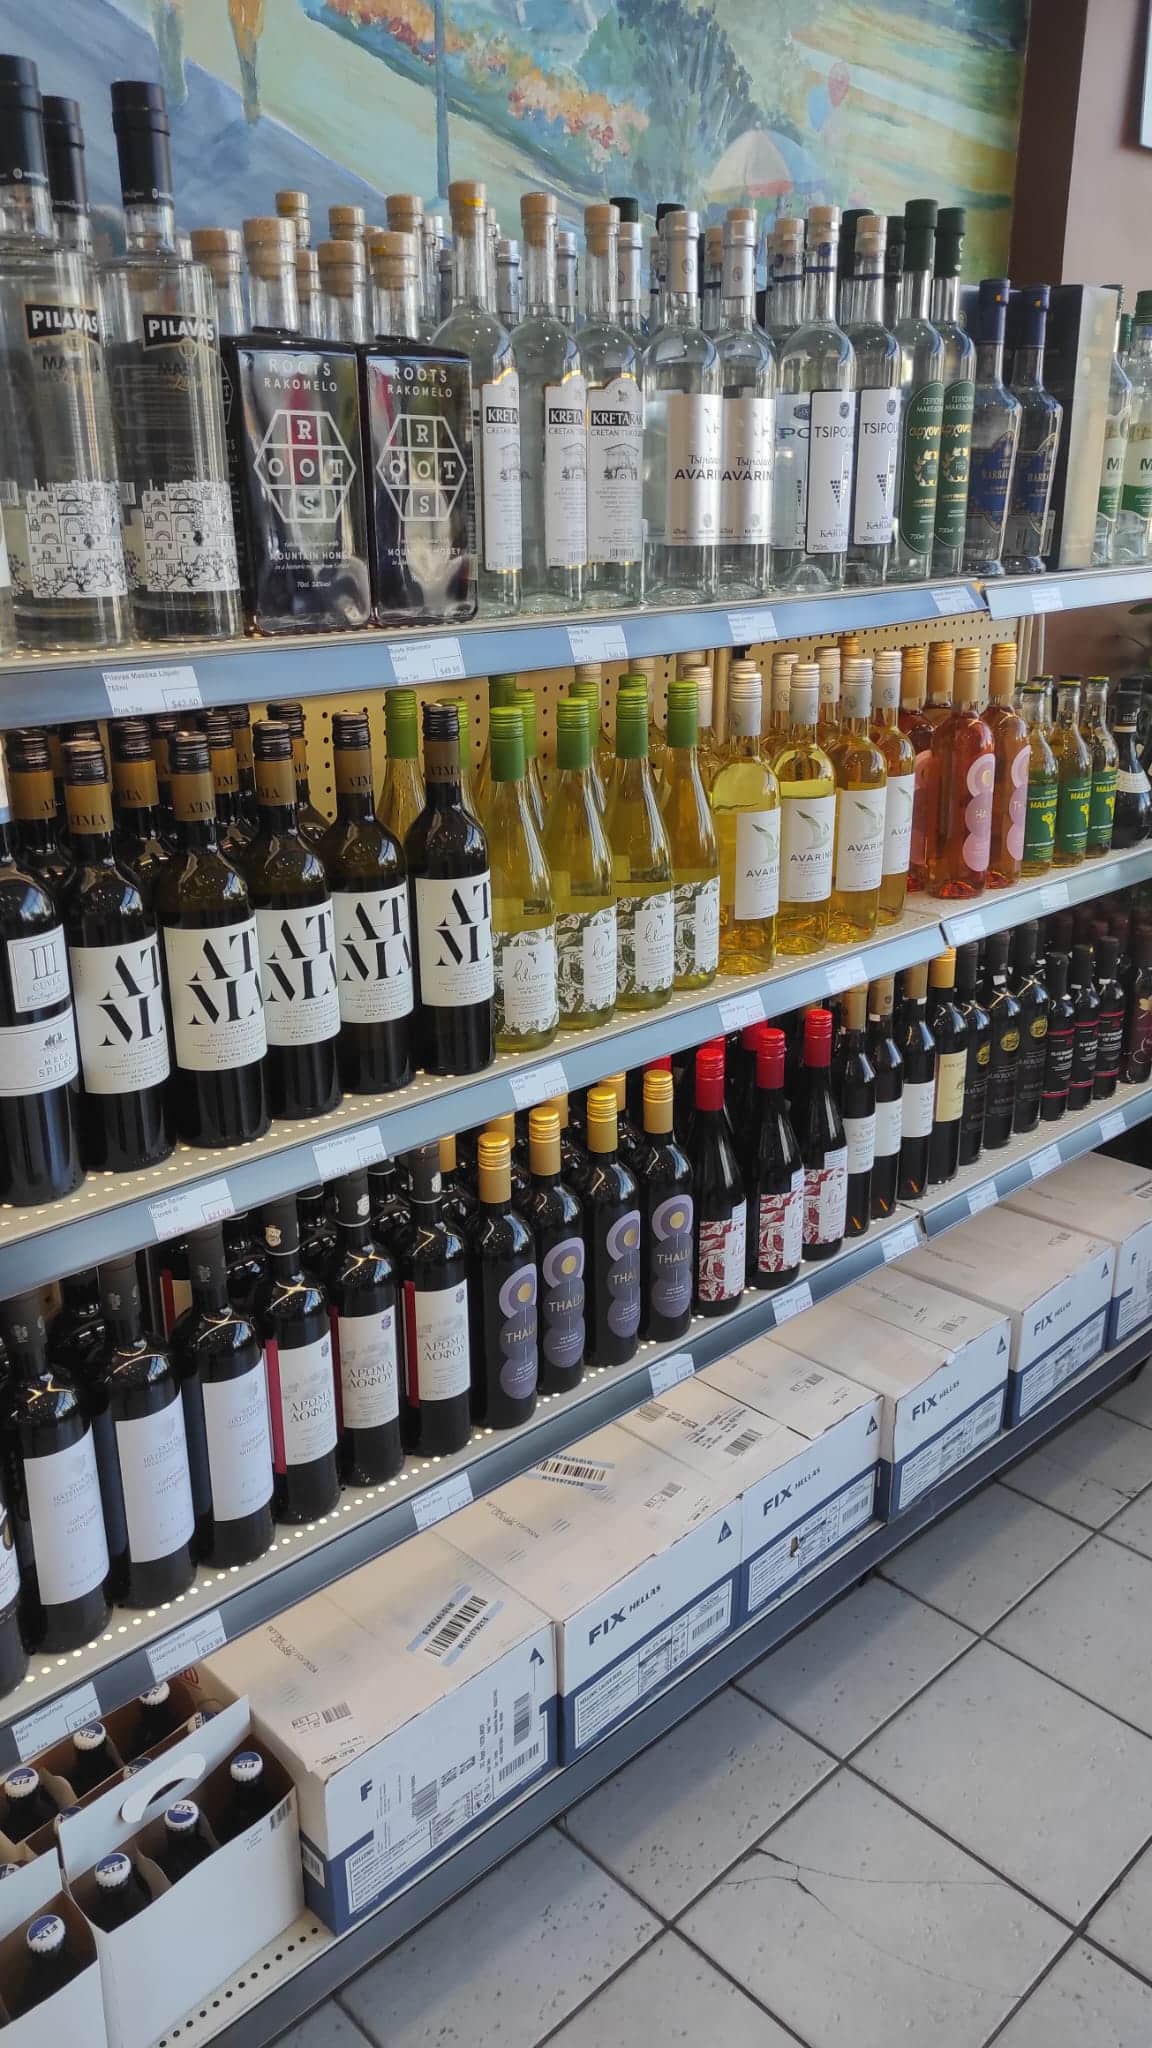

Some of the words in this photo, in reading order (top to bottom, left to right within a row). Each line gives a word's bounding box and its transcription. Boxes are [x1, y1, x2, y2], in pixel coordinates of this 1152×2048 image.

[31, 309, 98, 334] PILAVAS
[148, 319, 214, 341] PILAVAS
[268, 358, 331, 377] ROOTS
[392, 367, 448, 383] ROOTS
[263, 377, 338, 393] RAKOMELO
[387, 383, 453, 398] RAKOMELO
[1033, 1312, 1053, 1336] FIX
[911, 1396, 938, 1421] FIX
[762, 1484, 792, 1516] FIX
[794, 1466, 821, 1489] HELLAS
[588, 1607, 628, 1646] FIX
[629, 1583, 661, 1612] HELLAS
[174, 1803, 194, 1813] FIX
[102, 1862, 125, 1875] FIX
[38, 1923, 59, 1942] FIX
